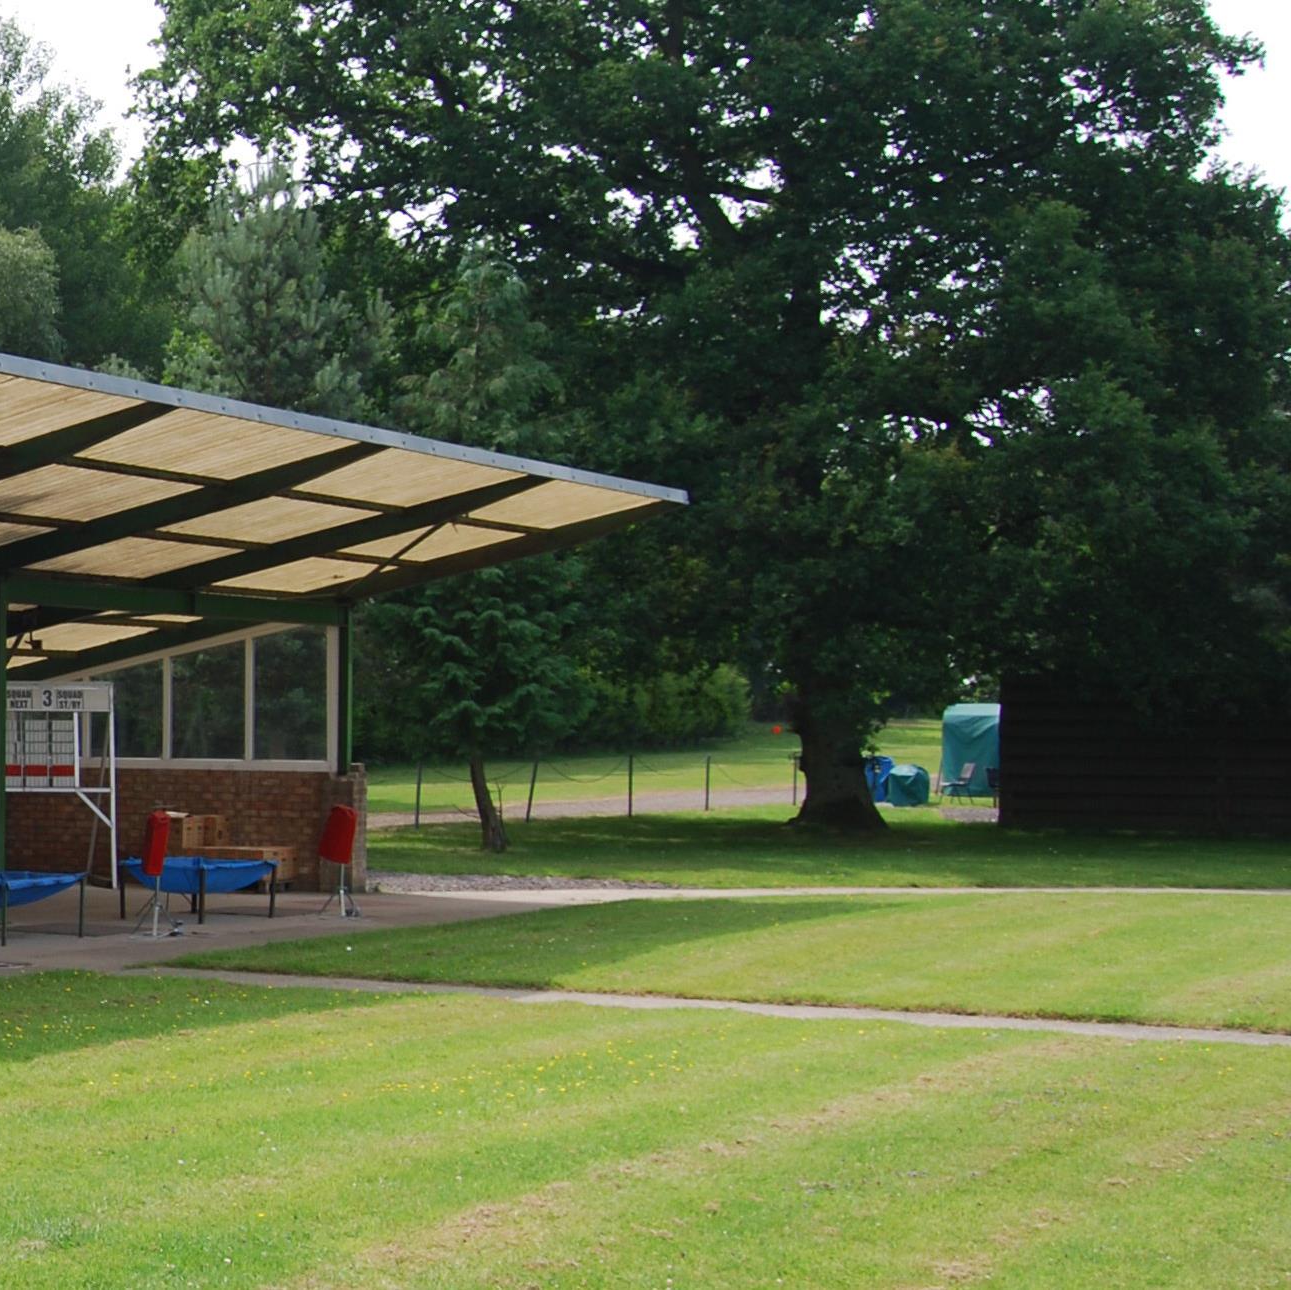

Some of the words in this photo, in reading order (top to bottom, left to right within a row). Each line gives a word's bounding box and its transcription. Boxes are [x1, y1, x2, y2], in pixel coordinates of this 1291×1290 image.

[6, 689, 32, 699] SQUAD
[42, 689, 53, 707] 3
[58, 689, 83, 699] SQUAD
[10, 700, 28, 709] NEXT
